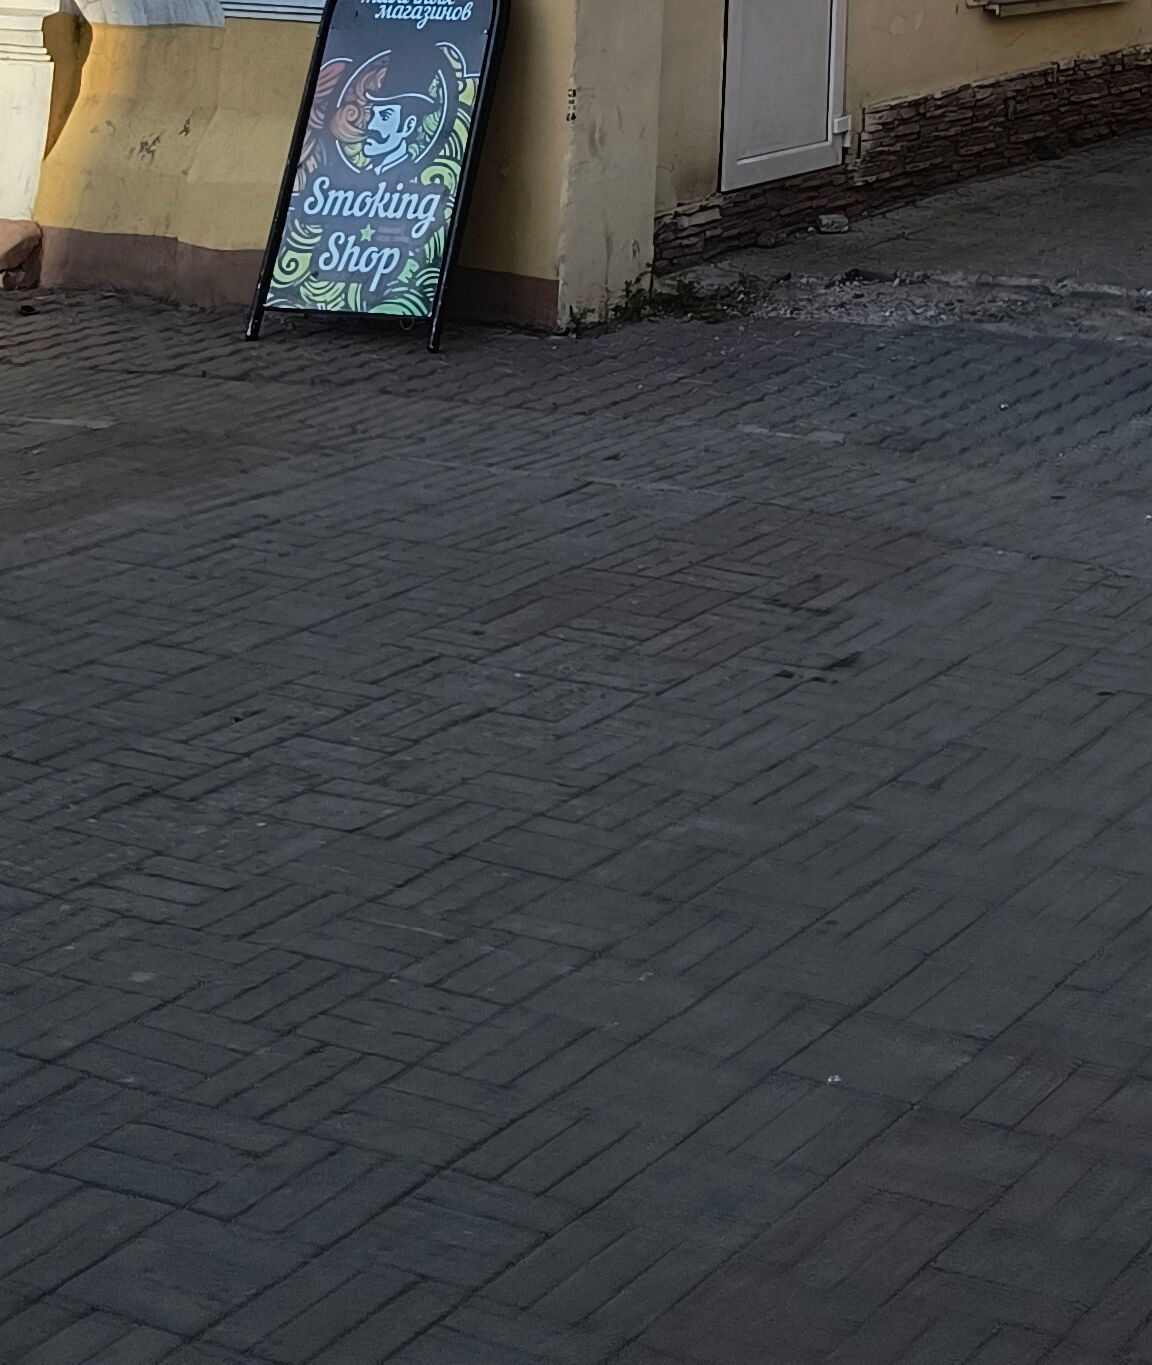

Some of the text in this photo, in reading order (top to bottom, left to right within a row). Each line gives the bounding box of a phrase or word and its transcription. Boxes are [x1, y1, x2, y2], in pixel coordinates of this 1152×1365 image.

[374, 1, 474, 30] магазинов
[303, 175, 442, 239] Smoking
[317, 231, 402, 292] Shop
